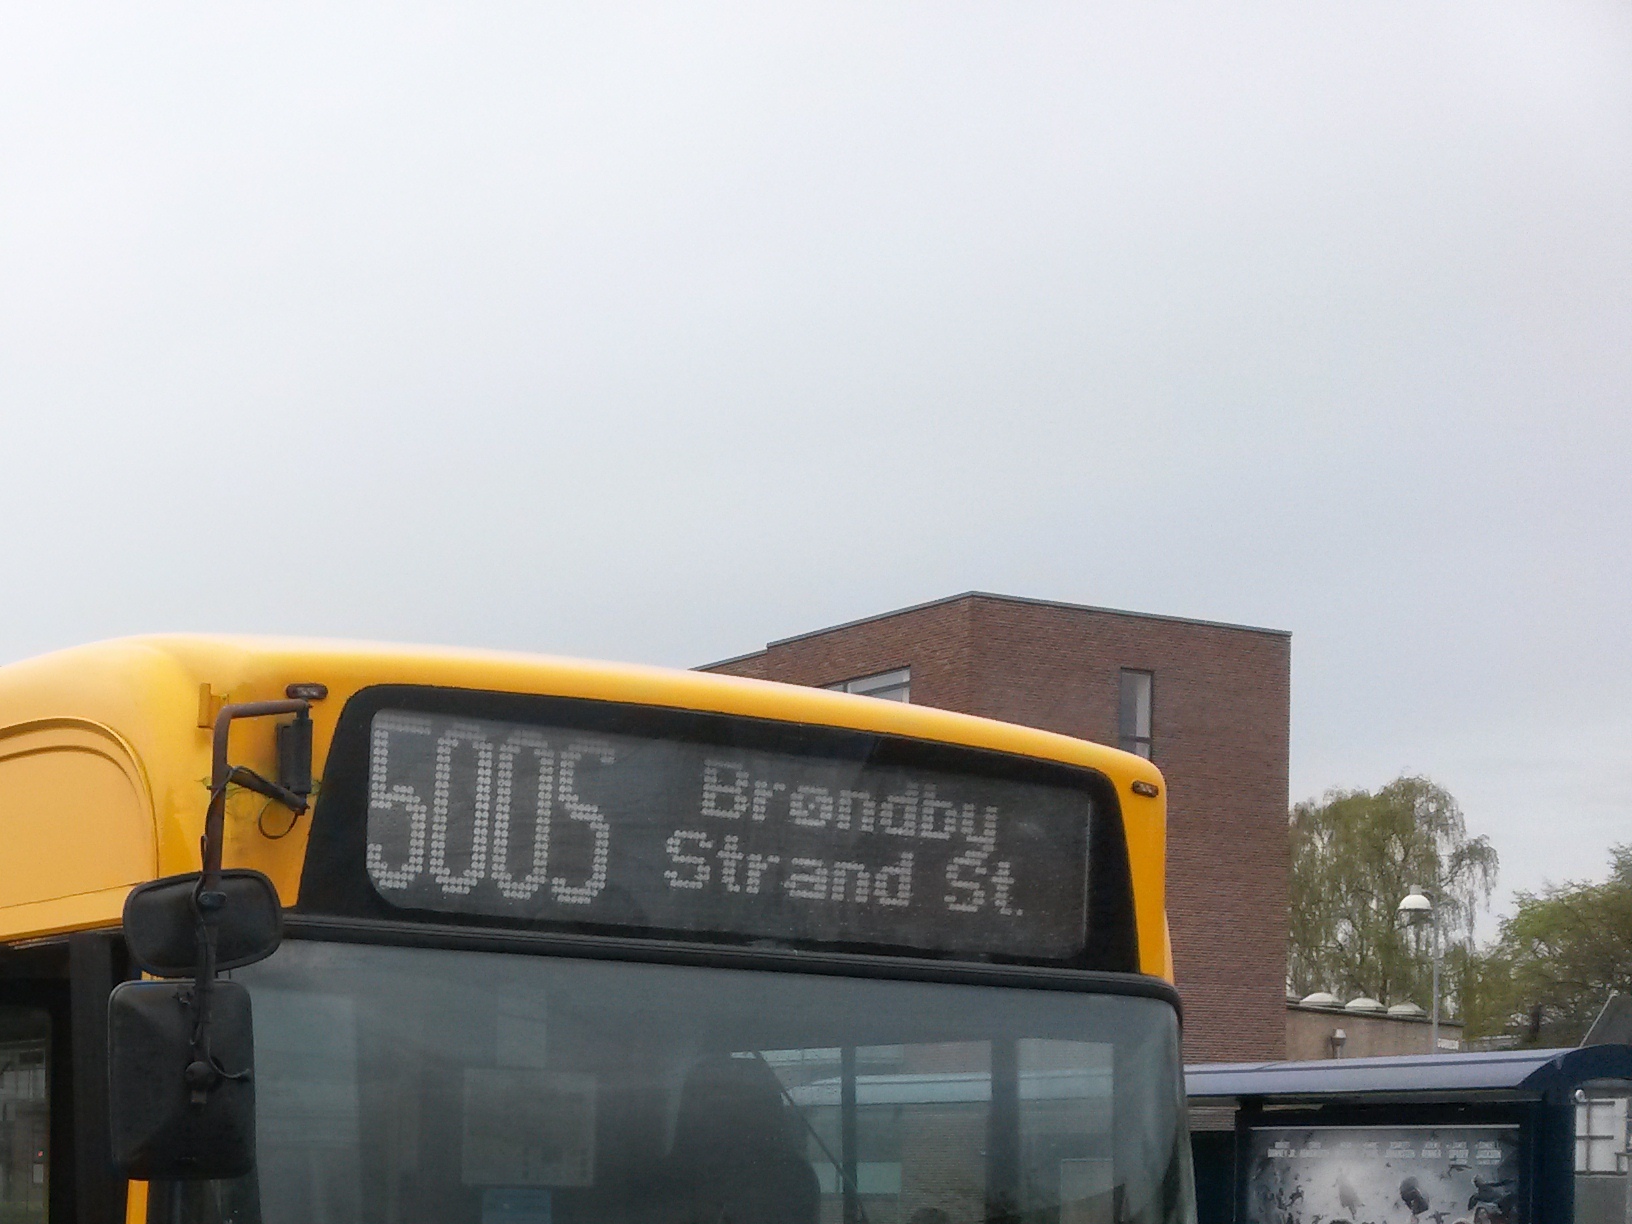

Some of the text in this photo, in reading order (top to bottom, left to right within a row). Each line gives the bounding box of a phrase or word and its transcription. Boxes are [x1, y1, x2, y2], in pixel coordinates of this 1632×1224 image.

[700, 759, 999, 856] Brøndby
[664, 830, 1024, 915] Strand St.
